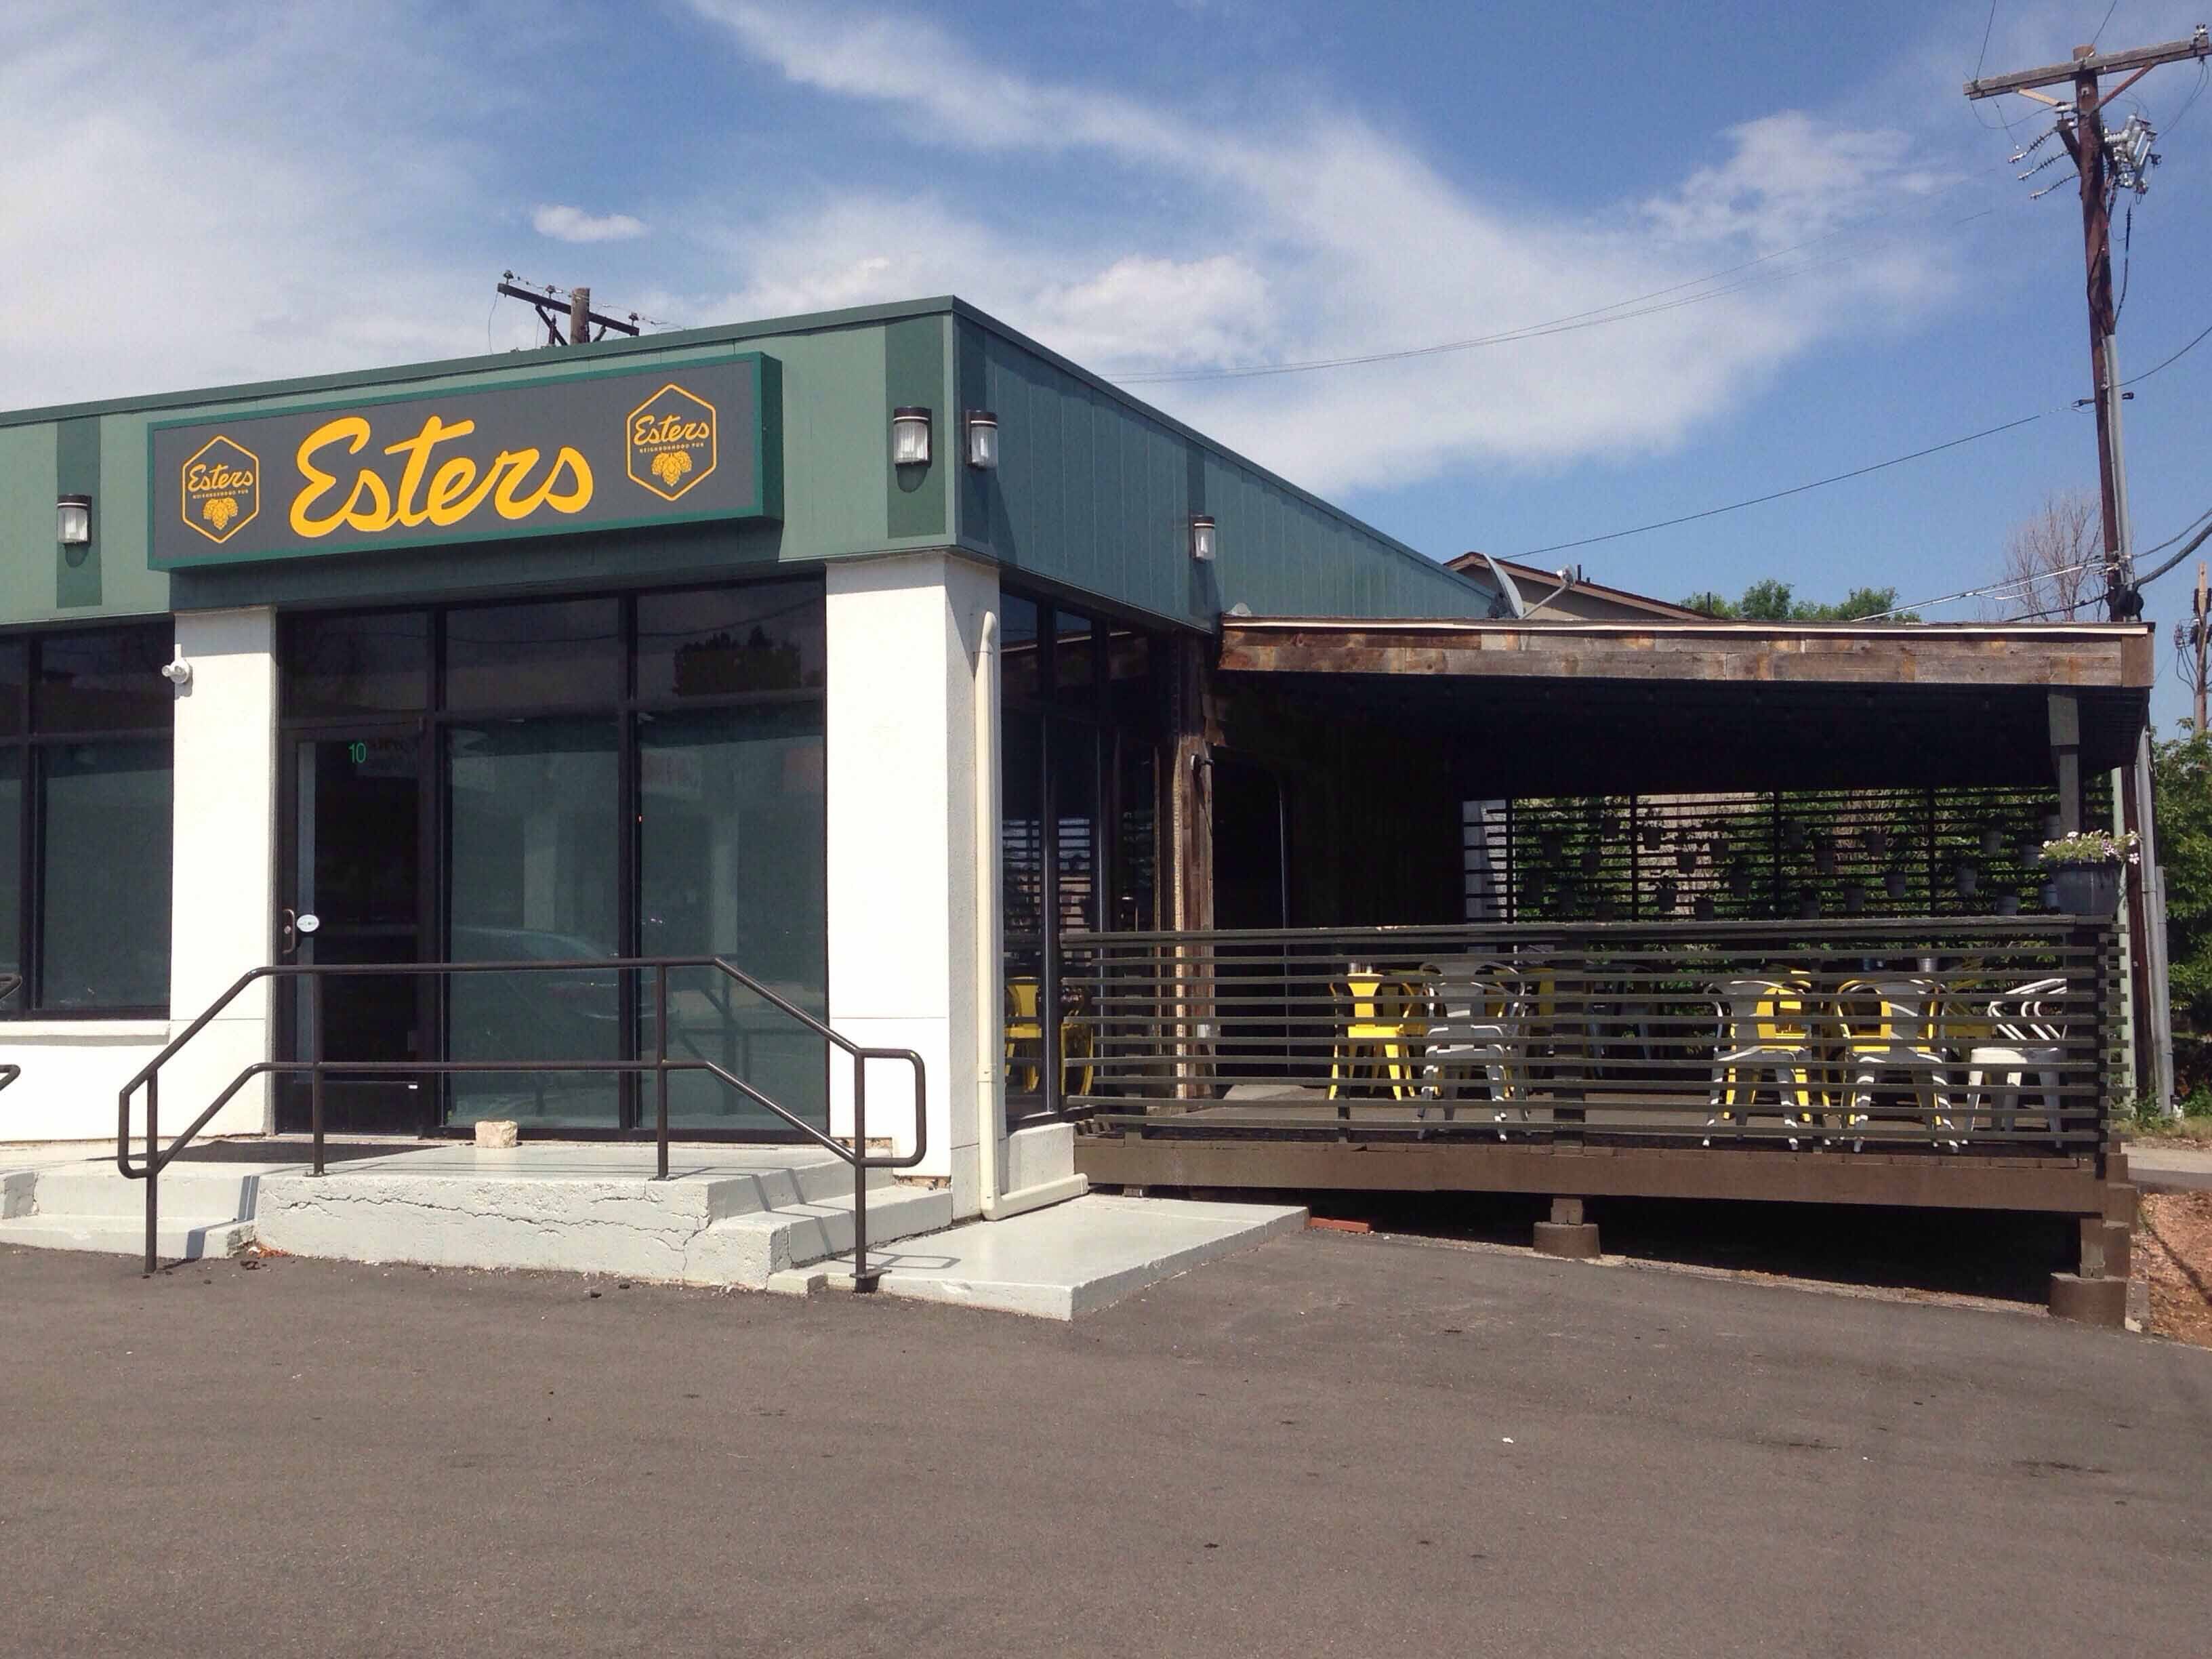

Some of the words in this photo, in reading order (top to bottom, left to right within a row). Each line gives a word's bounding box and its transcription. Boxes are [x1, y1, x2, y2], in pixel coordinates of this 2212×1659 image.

[633, 414, 710, 445] Esters
[188, 464, 253, 492] Esters
[289, 415, 594, 537] Esters
[348, 742, 367, 764] 10
